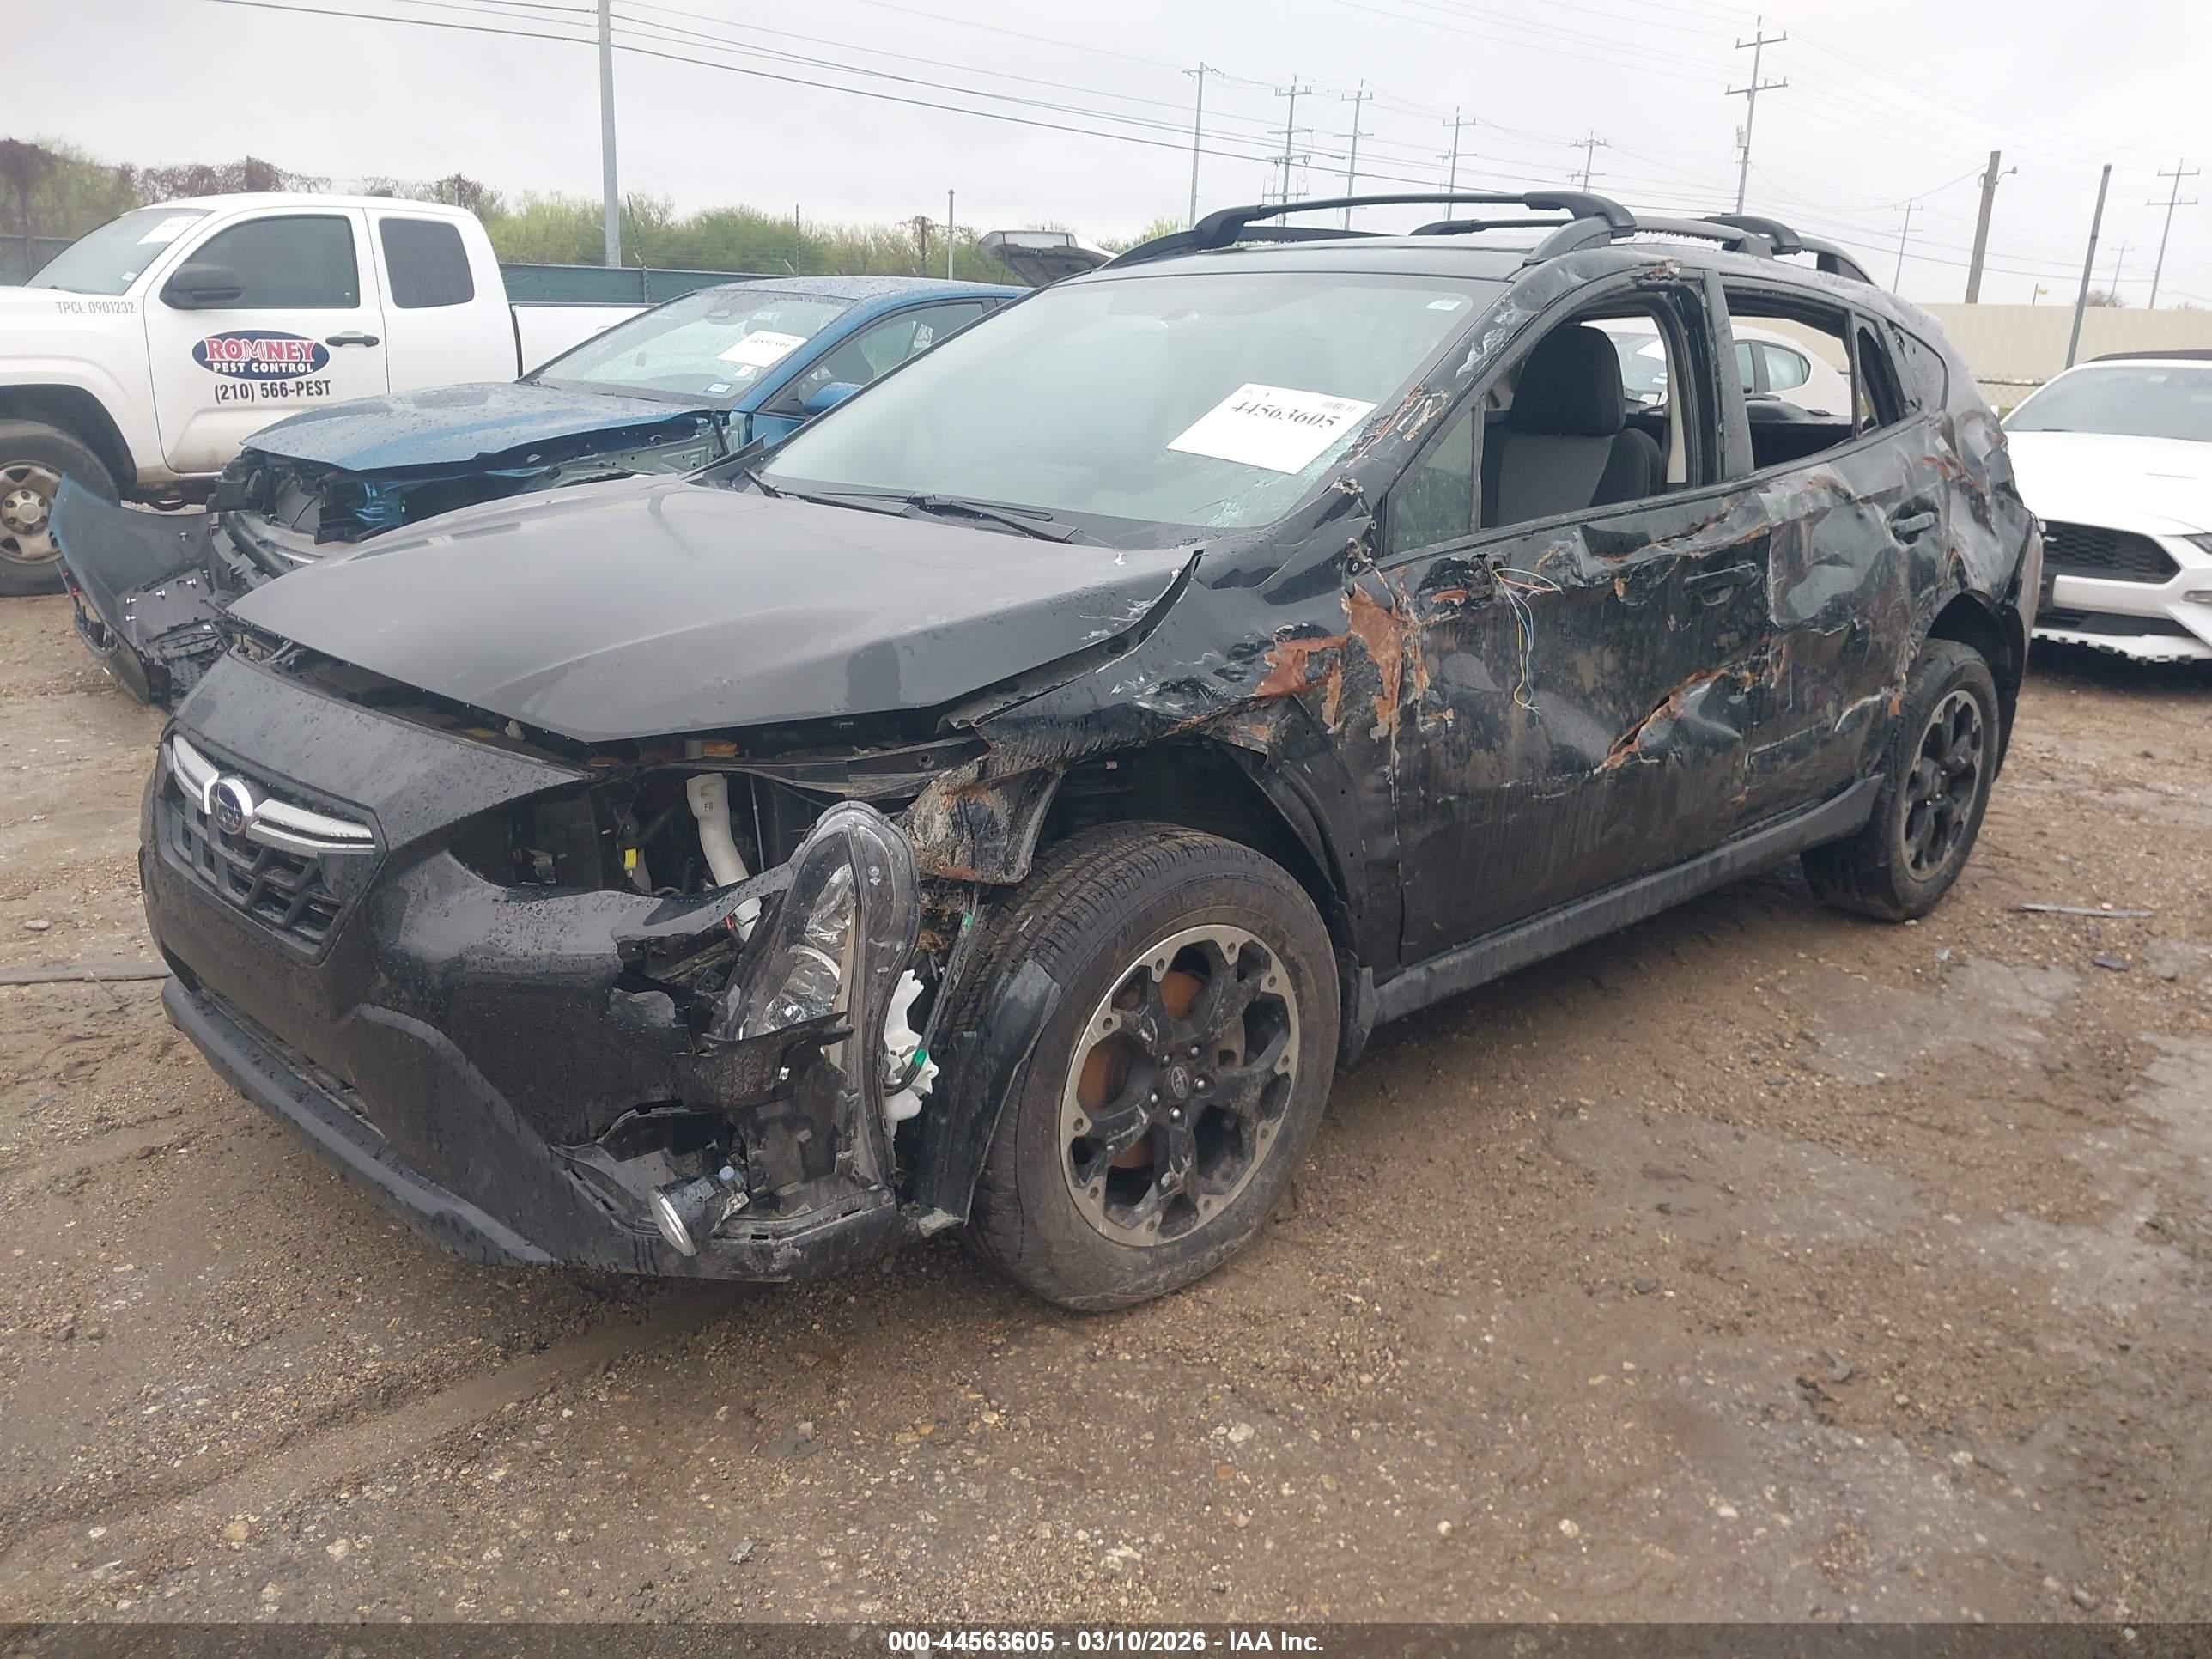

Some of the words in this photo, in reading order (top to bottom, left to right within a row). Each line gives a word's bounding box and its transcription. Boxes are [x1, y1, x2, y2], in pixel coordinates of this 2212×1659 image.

[56, 301, 87, 314] TPCL
[88, 301, 136, 314] 0901232
[205, 338, 316, 362] ROMNEY
[213, 362, 246, 373] PEST
[251, 362, 313, 374] CONTROL
[215, 383, 255, 404] (210)
[260, 380, 331, 398] 566-PEST
[1231, 401, 1341, 428] 44563605
